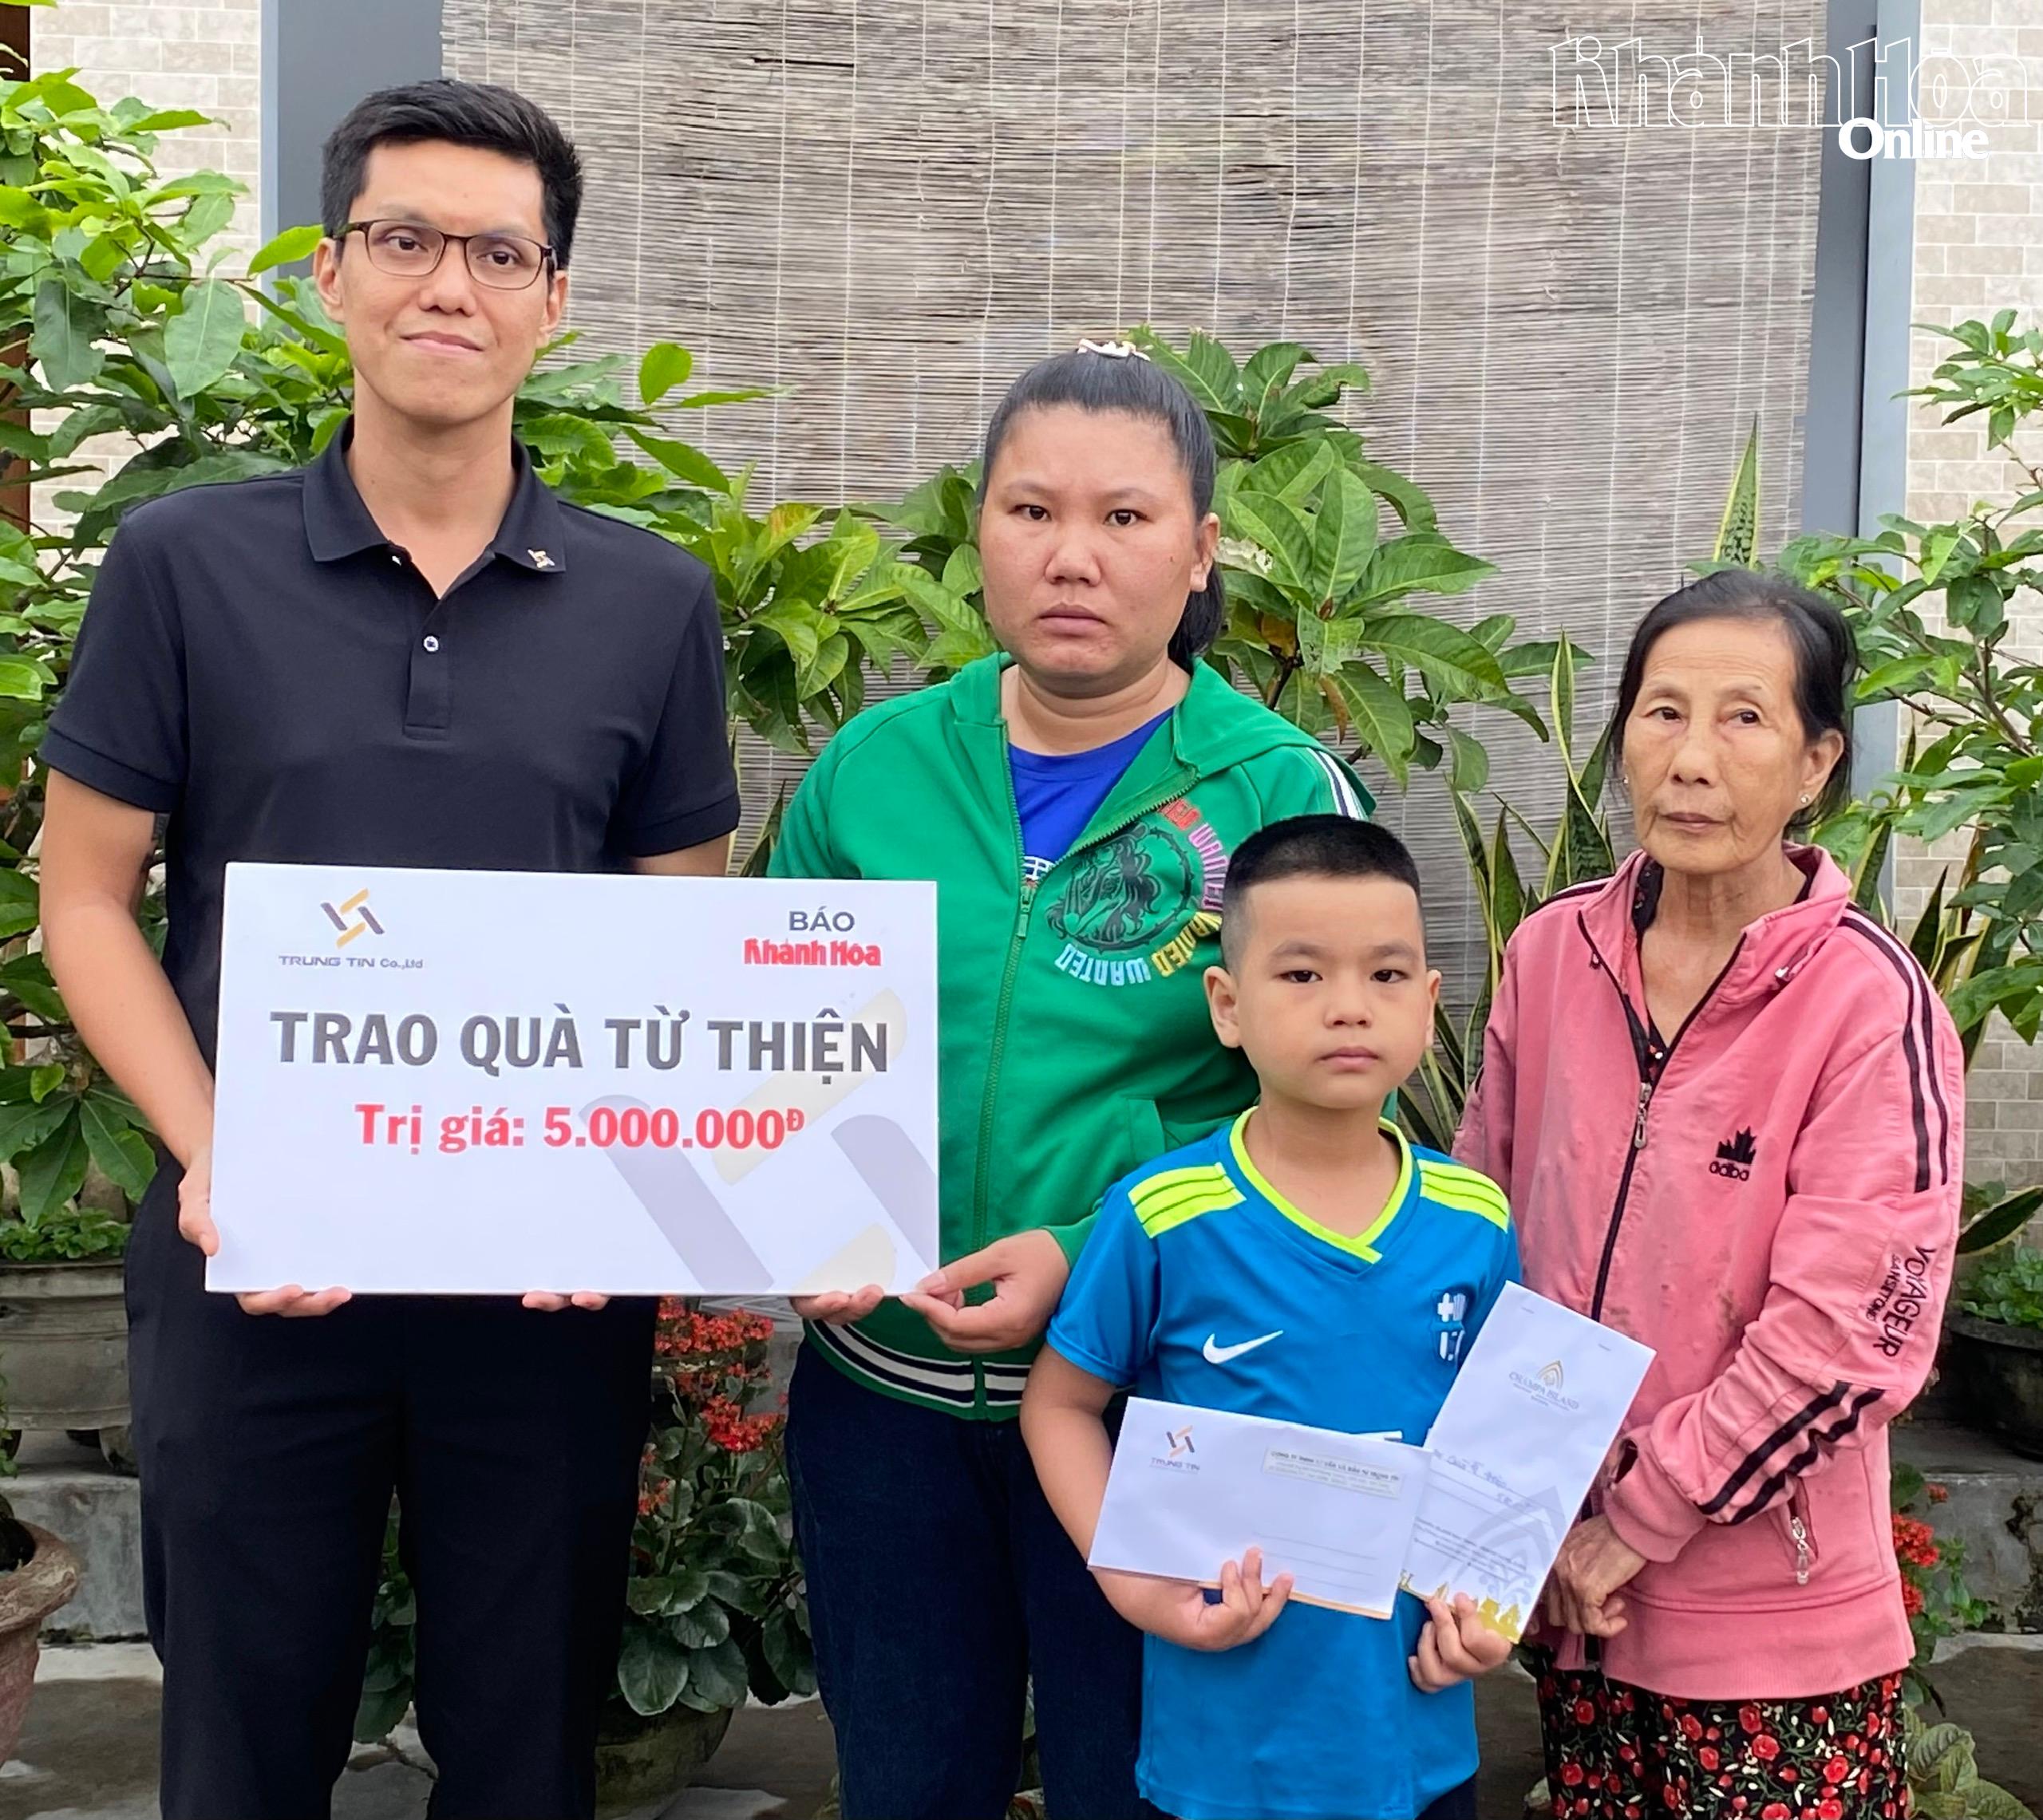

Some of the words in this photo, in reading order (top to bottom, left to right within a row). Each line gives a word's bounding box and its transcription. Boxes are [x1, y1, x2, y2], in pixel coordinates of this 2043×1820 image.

[789, 906, 855, 931] BÁO
[279, 955, 341, 967] TRUNG
[346, 957, 375, 968] TIN
[1054, 943, 1151, 985] WANTED
[270, 1011, 438, 1067] TRAO
[460, 1003, 583, 1077] QUÀ
[604, 1005, 690, 1070] TỪ
[707, 1008, 887, 1085] THIỆN
[354, 1103, 423, 1155] Trị
[438, 1106, 524, 1154] giá:
[1872, 1246, 1937, 1357] VOYAGEUR
